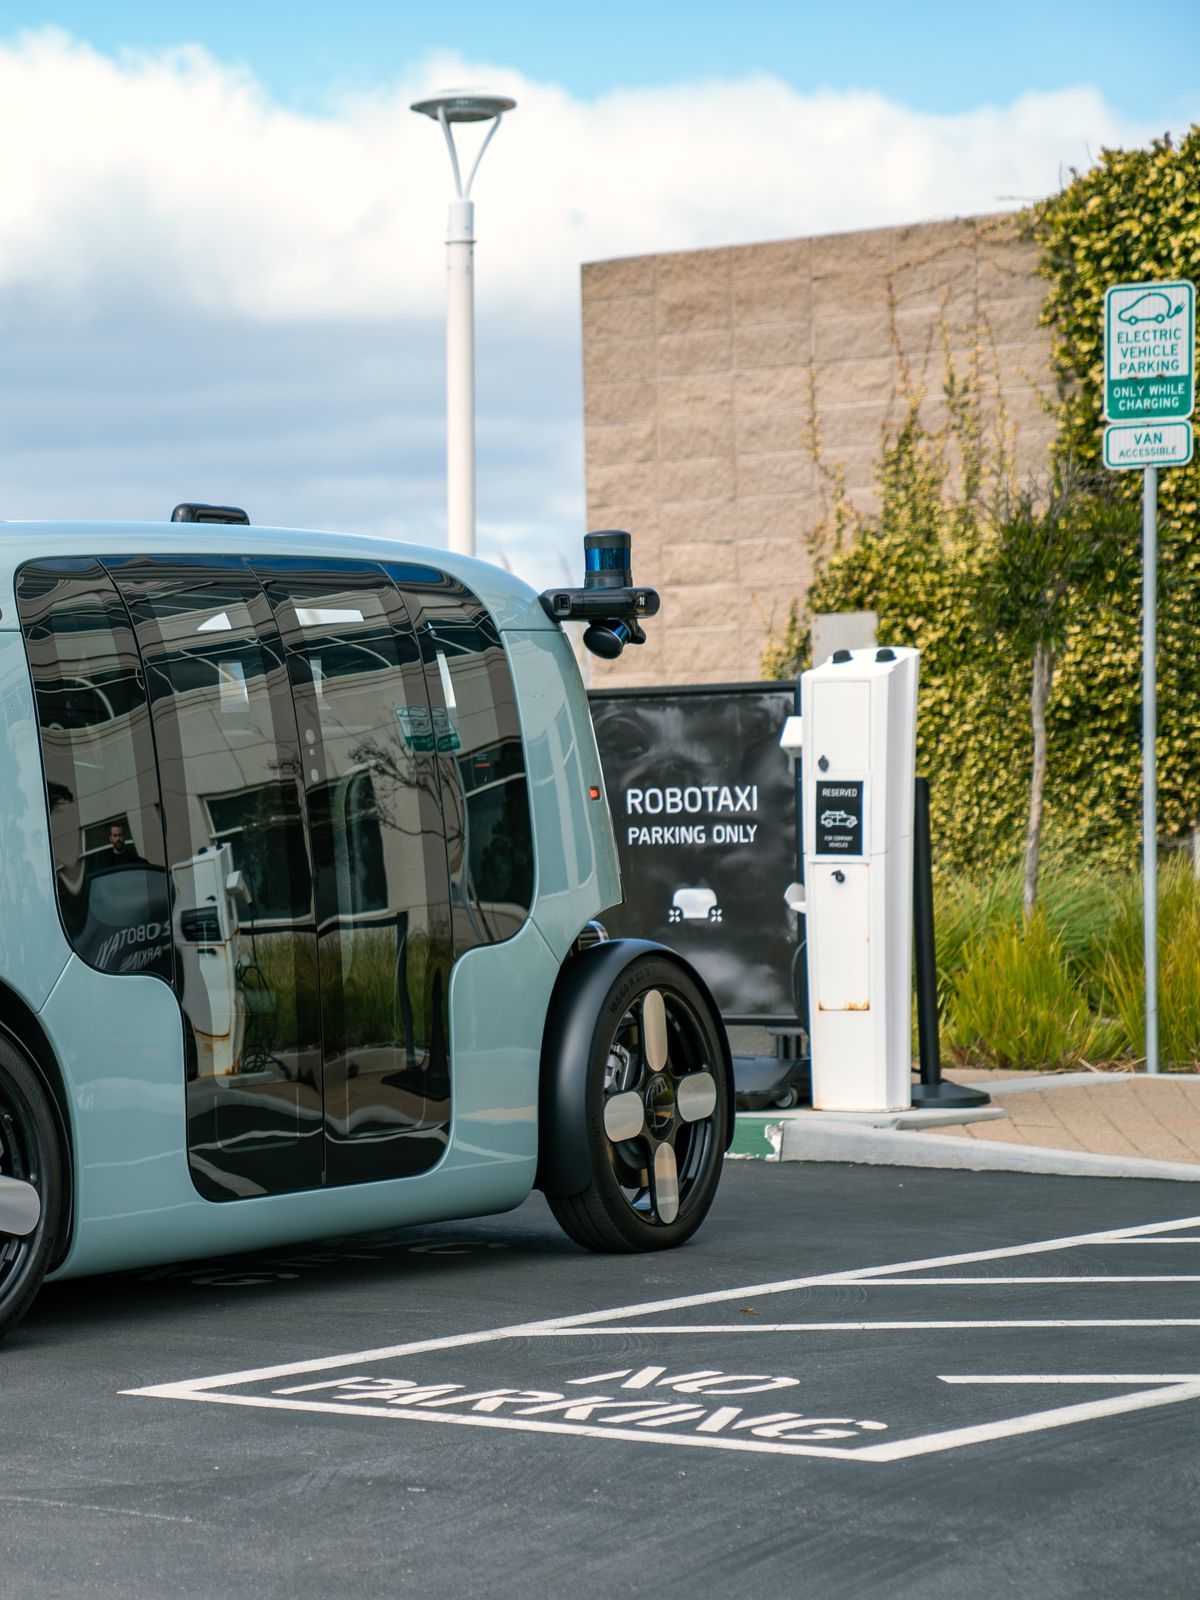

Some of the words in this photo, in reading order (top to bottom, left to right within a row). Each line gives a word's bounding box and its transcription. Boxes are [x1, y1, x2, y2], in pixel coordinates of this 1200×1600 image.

[1117, 328, 1182, 344] ELECTRIC
[1120, 344, 1179, 359] VEHICLE
[1119, 360, 1179, 375] PARKING
[1113, 386, 1144, 399] ONLY
[1149, 383, 1185, 396] WHILE
[1118, 397, 1179, 411] CHARGING
[1134, 432, 1162, 445] VAN
[1118, 446, 1177, 459] ACCESSIBLE
[626, 785, 758, 814] ROBOTAXI
[822, 788, 858, 797] RESERVED
[628, 826, 706, 845] PARKING
[713, 824, 758, 844] ONLY
[565, 1366, 800, 1395] NO
[271, 1376, 888, 1440] PARKING
